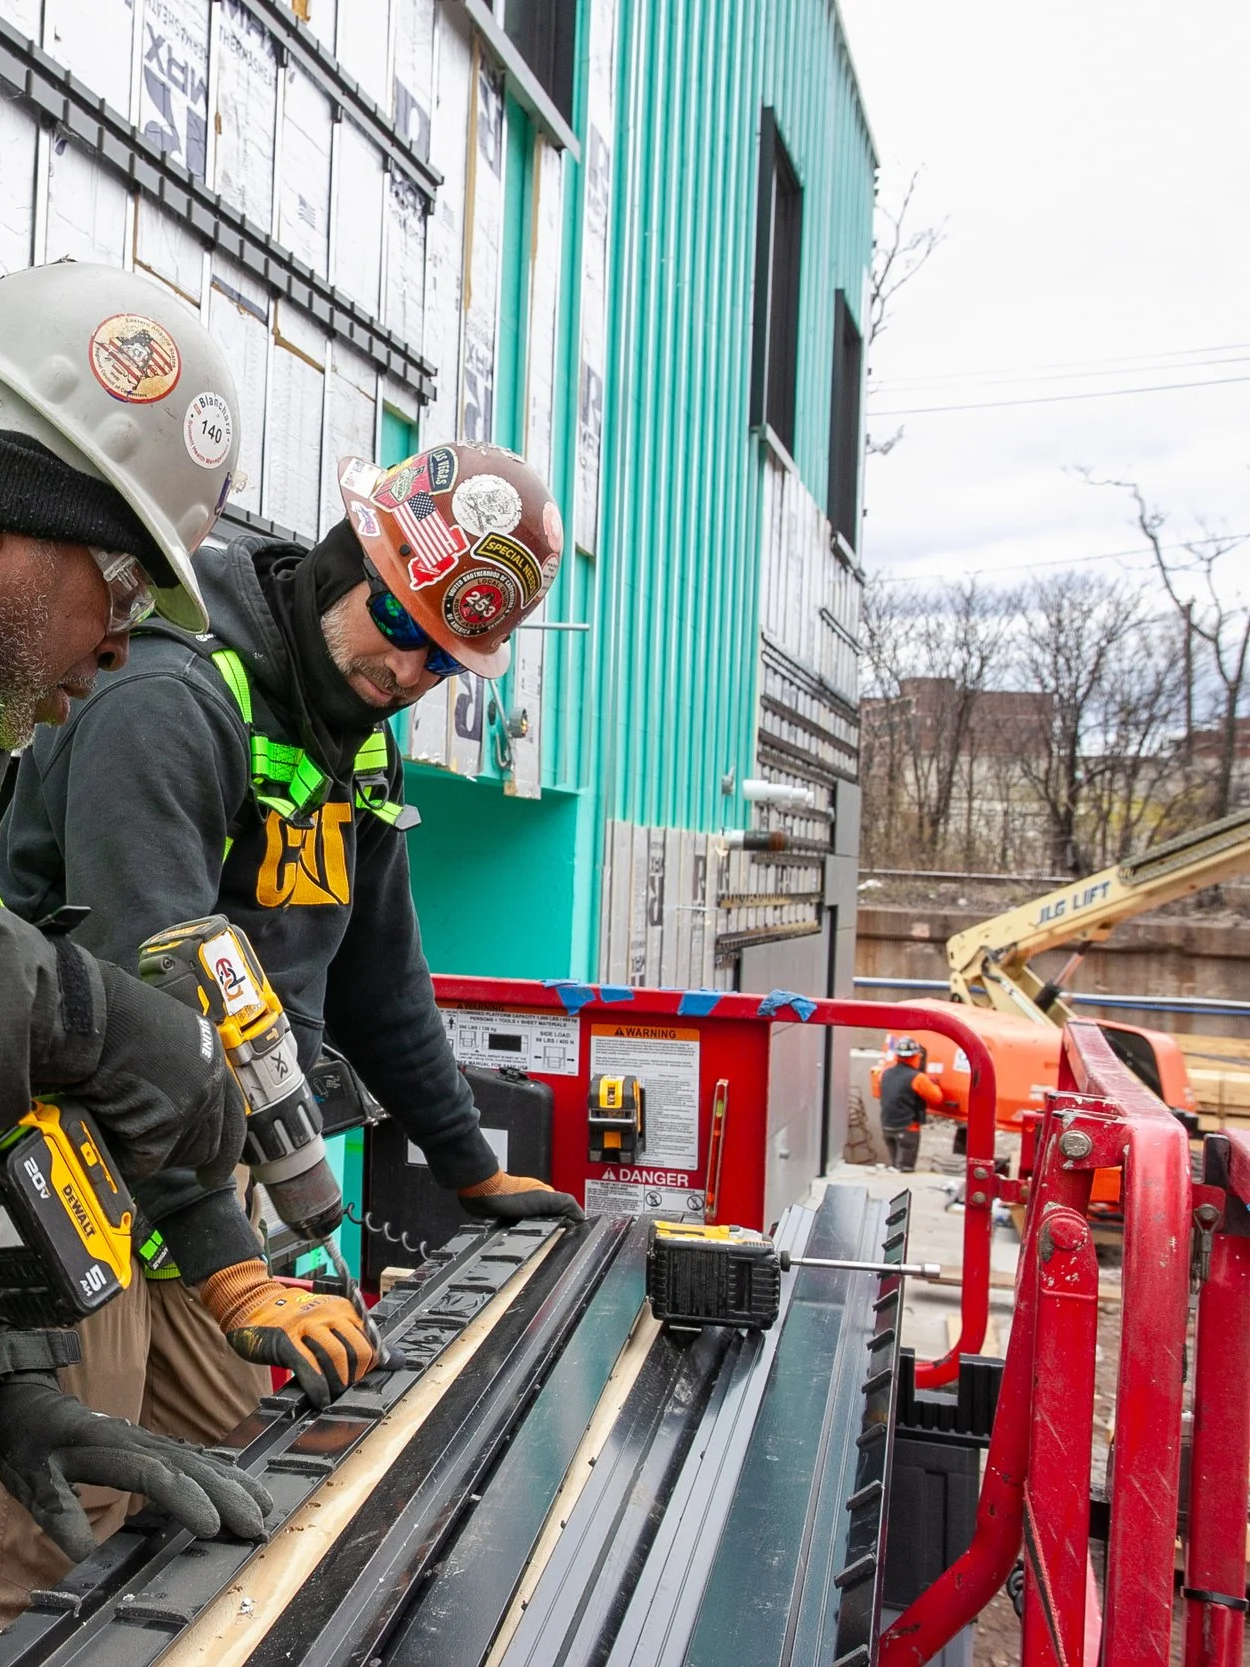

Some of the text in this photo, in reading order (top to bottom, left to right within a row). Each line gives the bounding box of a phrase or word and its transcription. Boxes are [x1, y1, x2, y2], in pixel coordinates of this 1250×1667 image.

[198, 395, 231, 435] Blanchard
[202, 419, 223, 444] 140
[435, 462, 450, 485] VEGAS
[486, 541, 524, 569] SPECIAL
[448, 580, 463, 597] UNITED
[462, 570, 501, 583] BROTHERHOOD
[499, 574, 508, 582] OF
[477, 578, 501, 589] LOCAL
[466, 591, 497, 618] 253
[450, 618, 471, 636] AMERICA
[256, 801, 352, 908] CAT
[1036, 880, 1111, 927] JLG LIFT
[197, 1018, 214, 1060] ULINE
[626, 1028, 677, 1039] WARNING
[270, 1050, 289, 1080] XR
[23, 1156, 51, 1200] 20V
[619, 1168, 689, 1187] DANGER
[62, 1183, 96, 1239] DEWALT
[79, 1279, 93, 1298] AH
[84, 1263, 108, 1292] 5
